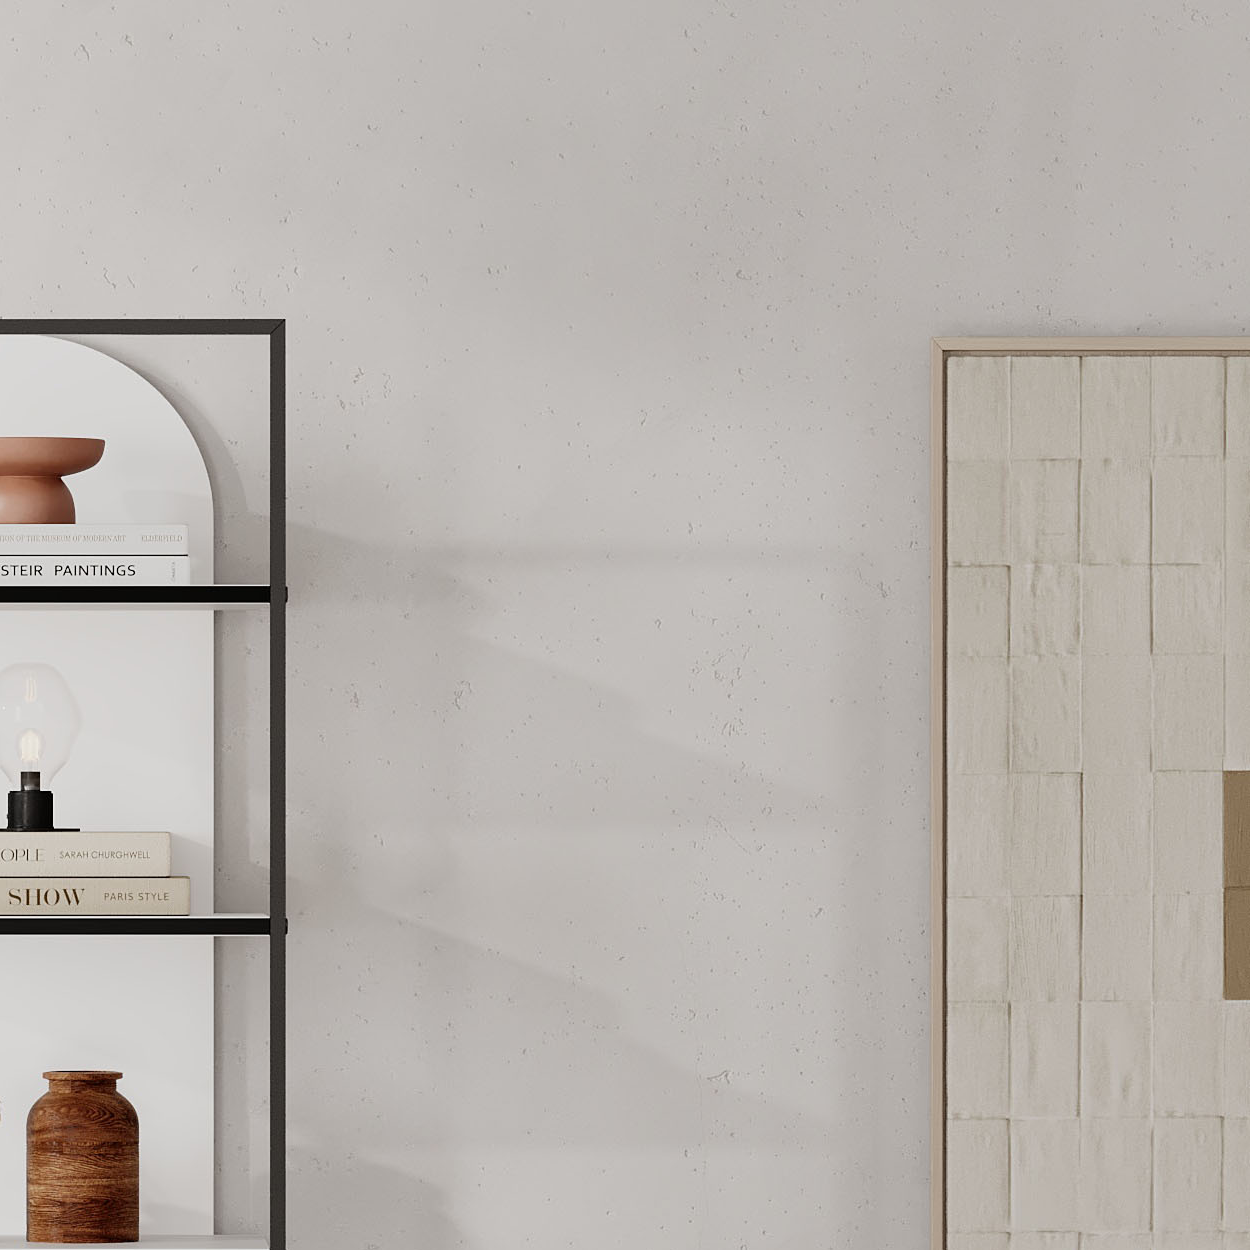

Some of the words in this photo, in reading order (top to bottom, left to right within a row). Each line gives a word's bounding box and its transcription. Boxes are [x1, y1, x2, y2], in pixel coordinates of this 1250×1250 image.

[0, 564, 43, 577] STEIR
[54, 564, 136, 577] PAINTINGS
[59, 850, 89, 860] SARAH
[8, 888, 85, 906] SHOW
[104, 892, 134, 901] PARIS
[138, 892, 170, 901] STYLE
